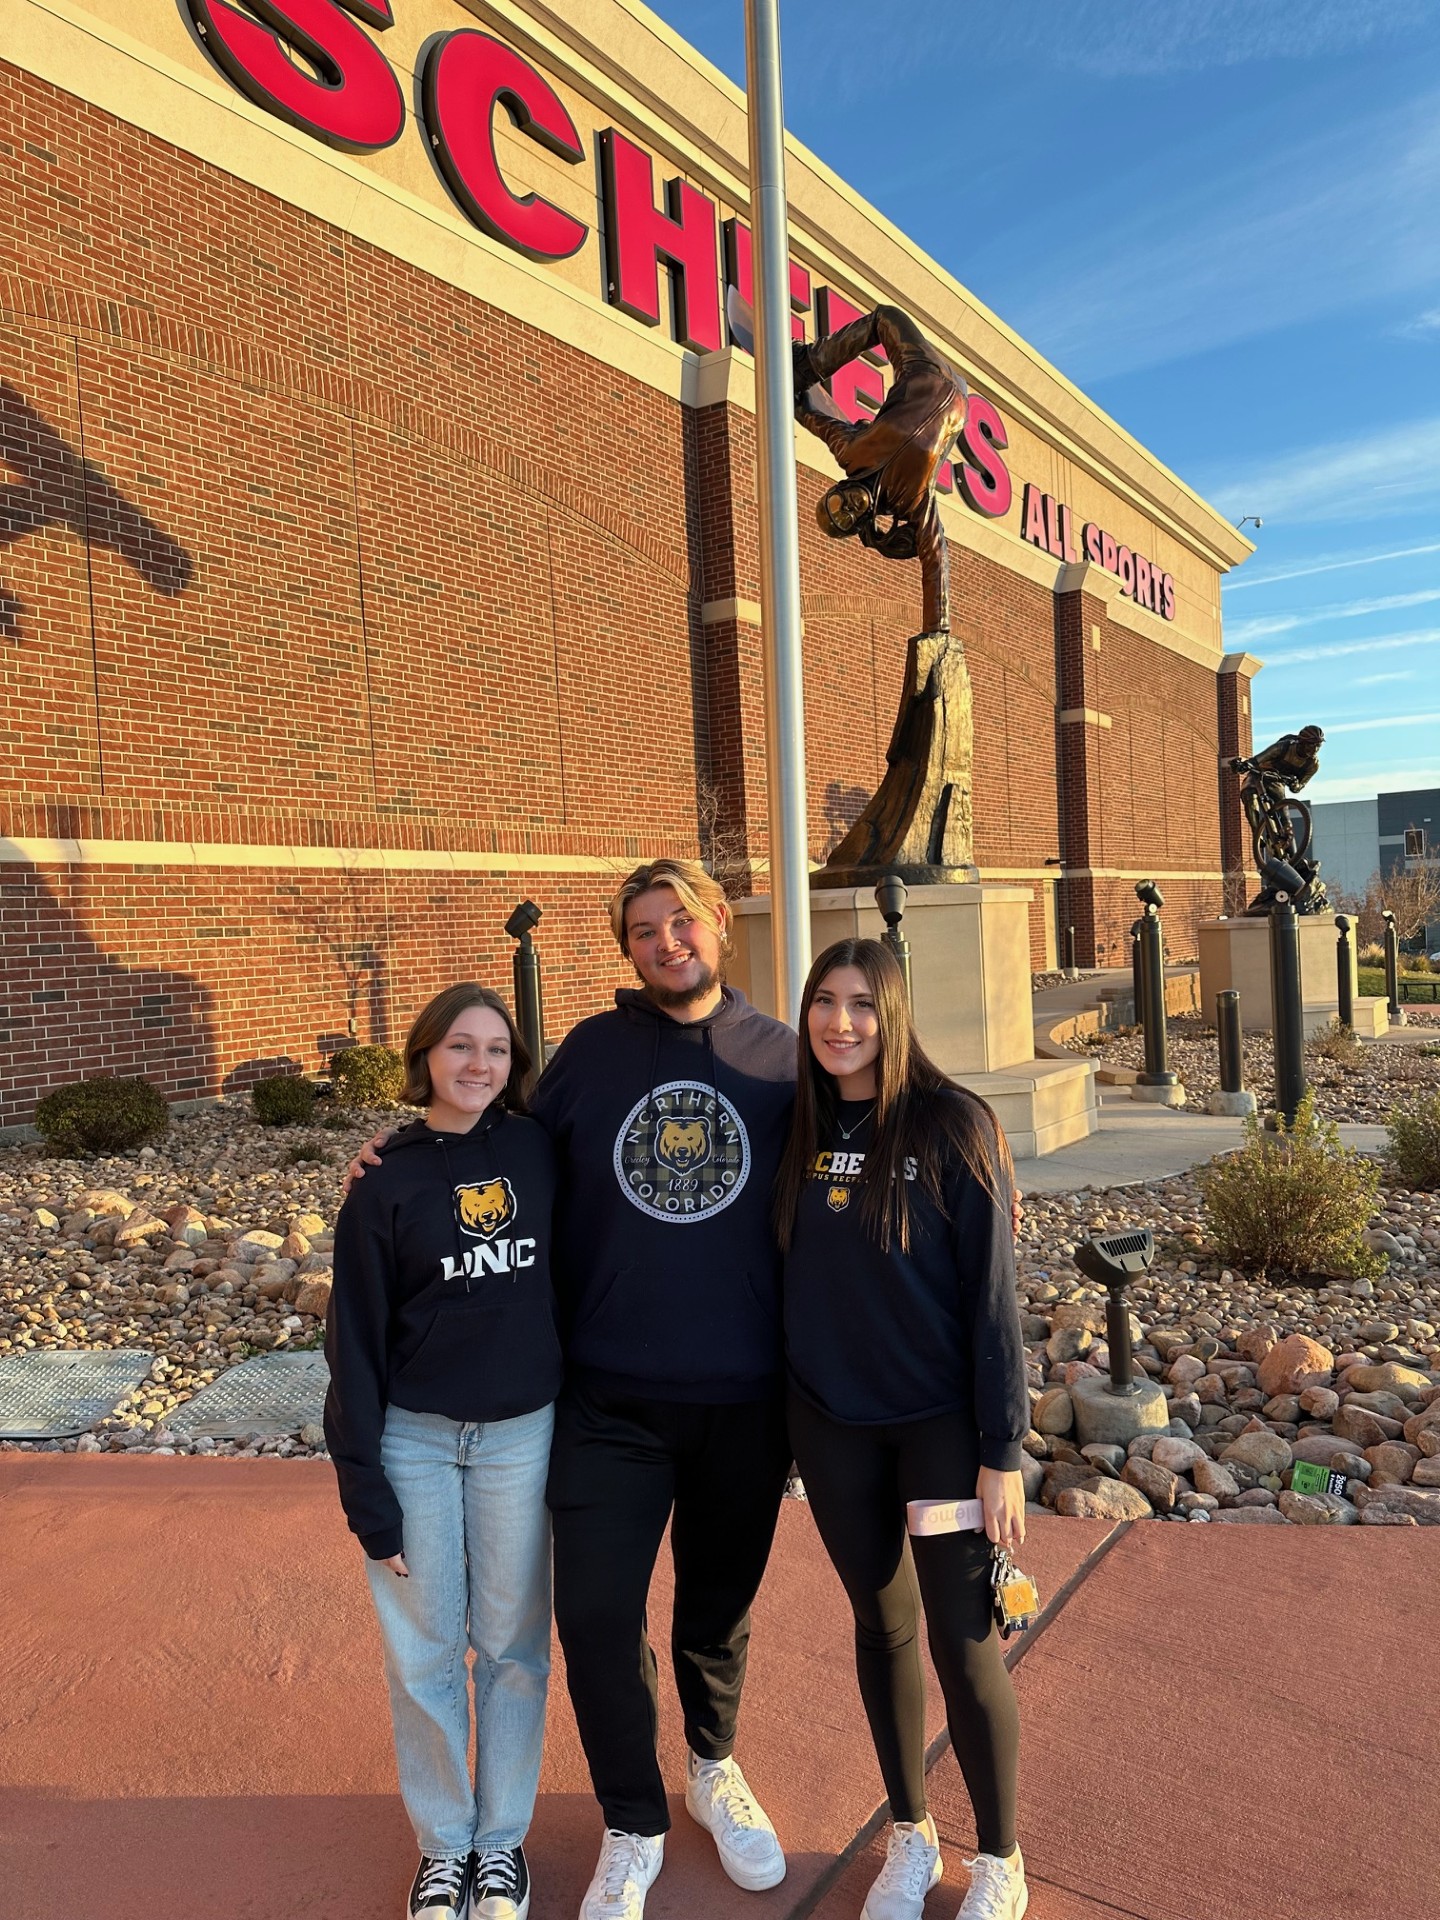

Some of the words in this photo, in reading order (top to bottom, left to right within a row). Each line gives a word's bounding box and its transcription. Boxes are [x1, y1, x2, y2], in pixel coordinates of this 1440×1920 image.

[1021, 483, 1077, 563] ALL
[1082, 522, 1176, 621] SPORTS
[626, 1090, 739, 1145] NORTHERN
[629, 1170, 736, 1212] COLORADO
[666, 1178, 699, 1191] 1889
[440, 1237, 536, 1281] UNC
